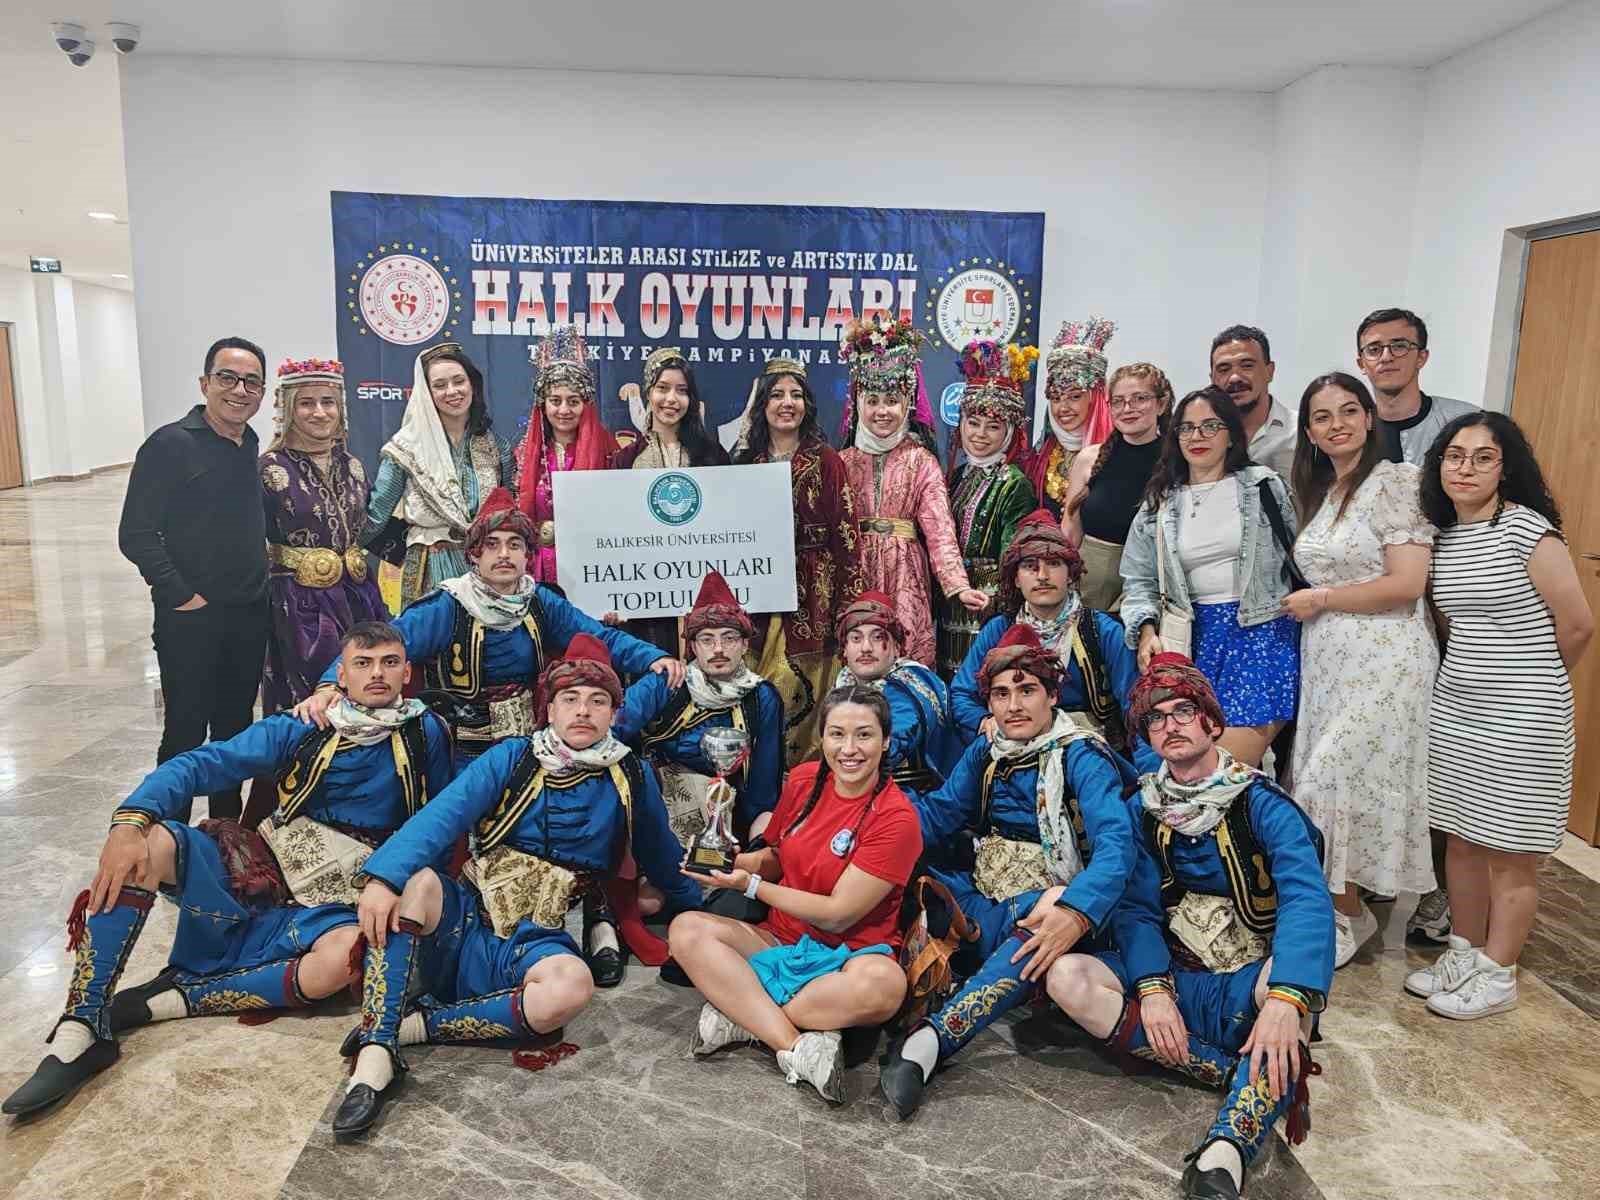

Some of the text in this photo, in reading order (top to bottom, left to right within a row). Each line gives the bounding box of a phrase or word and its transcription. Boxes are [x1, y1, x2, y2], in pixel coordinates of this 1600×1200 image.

[628, 246, 686, 266] ARASI
[766, 255, 786, 269] ve
[881, 253, 918, 271] DAL
[472, 270, 626, 337] HALK
[640, 272, 916, 340] OYUNLARI
[527, 342, 654, 361] TKİYE
[596, 530, 757, 549] BALIKESİR ÜNİVERSİTESİ
[583, 556, 774, 584] HALK OYUNLARI
